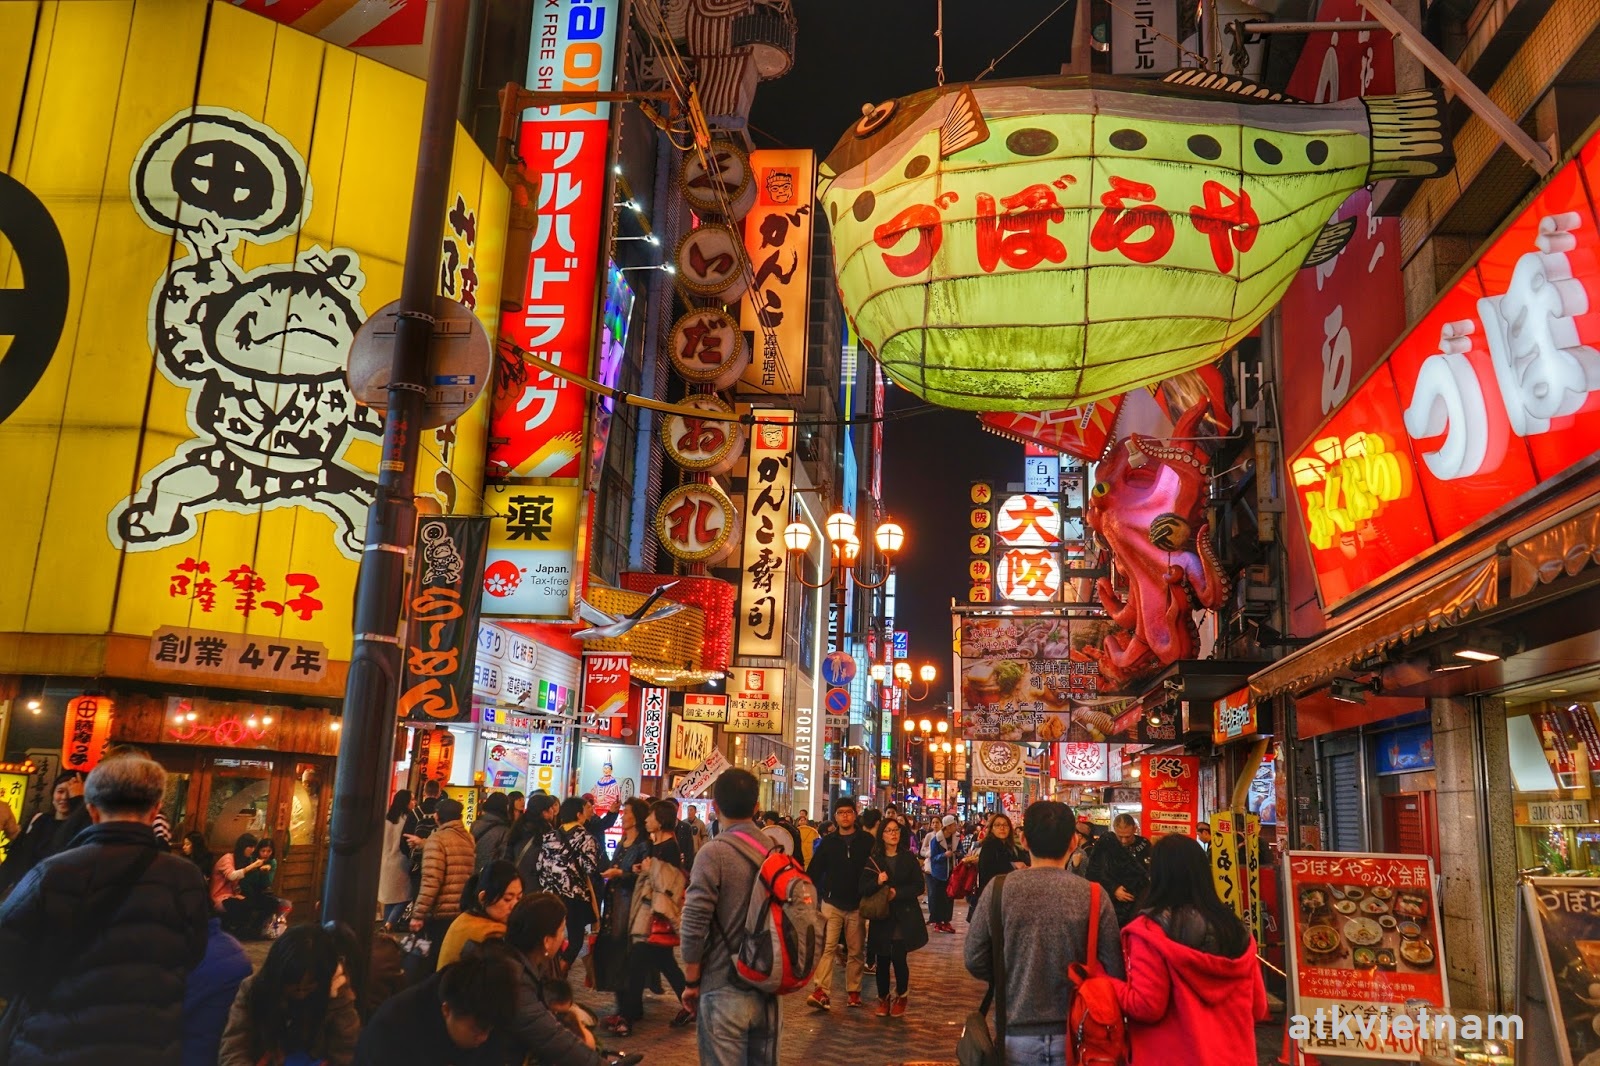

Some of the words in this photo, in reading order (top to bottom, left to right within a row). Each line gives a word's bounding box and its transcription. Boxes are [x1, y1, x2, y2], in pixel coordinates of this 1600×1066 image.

[540, 14, 558, 60] FREE
[559, 0, 606, 116] aox
[534, 66, 553, 116] SHP
[873, 174, 1259, 277] づぼらや
[515, 130, 585, 431] ツルハドラッグ
[505, 494, 554, 541] 薬
[973, 485, 988, 602] 大阪名物元
[995, 494, 1063, 597] 大阪
[169, 557, 324, 621] 薩摩っ子
[530, 576, 569, 586] Tax-free
[535, 564, 569, 575] Japan.
[543, 587, 568, 598] Shop
[155, 632, 228, 668] 創業
[238, 642, 323, 676] 47年
[397, 586, 464, 718] らーめん
[589, 657, 629, 672] ツルハ
[588, 673, 622, 684] ドラッグ
[794, 707, 812, 770] FOREVER
[973, 778, 999, 787] CAFE
[1291, 858, 1428, 887] づぼらやのふぐ会席
